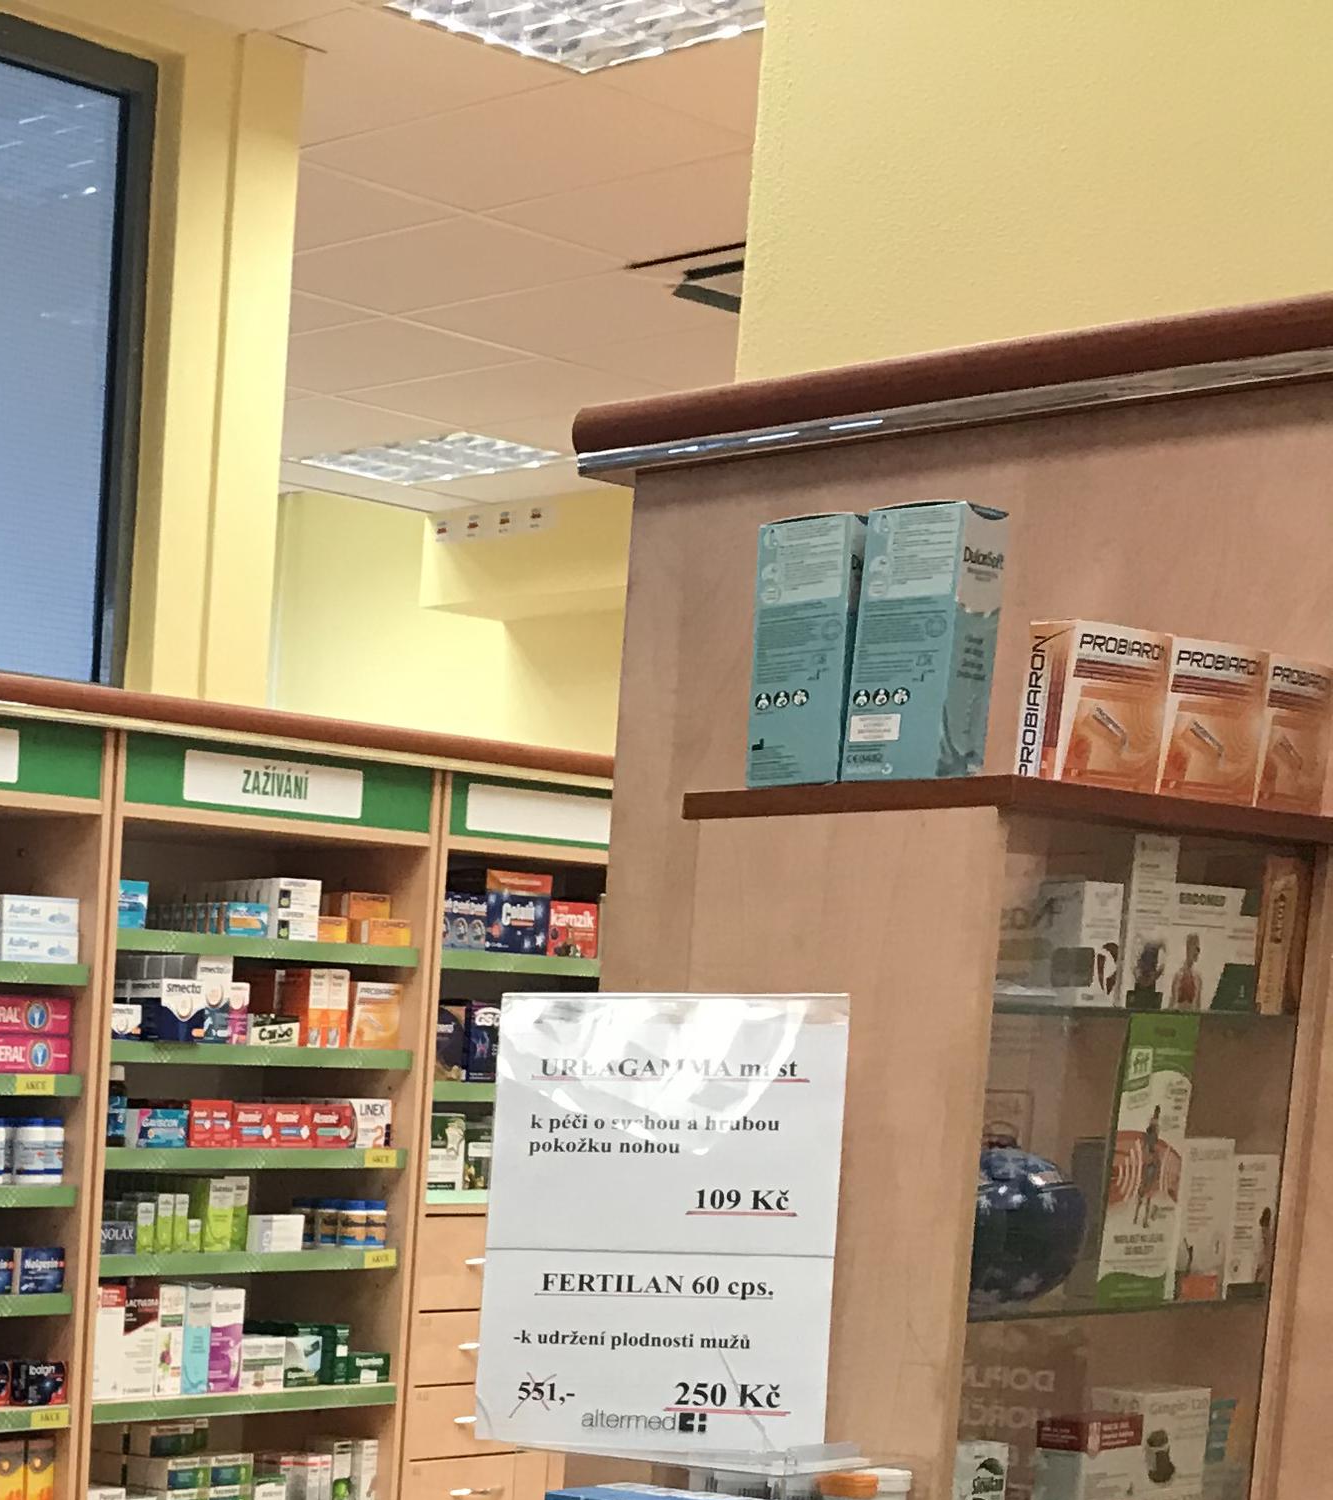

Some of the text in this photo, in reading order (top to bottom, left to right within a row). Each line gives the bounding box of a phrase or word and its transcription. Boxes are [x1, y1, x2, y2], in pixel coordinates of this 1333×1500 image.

[1018, 635, 1048, 777] PROBIARON
[241, 766, 309, 801] ZAŽÍVÁNÍ
[166, 982, 202, 995] smecta
[741, 1062, 798, 1078] mst
[531, 1114, 543, 1129] k
[549, 1113, 589, 1133] péči
[594, 1119, 605, 1130] o
[529, 1138, 680, 1156] pokožku nohou
[695, 1188, 790, 1211] 109 Kč
[542, 1272, 774, 1300] FERTILAN 60 cps.
[513, 1330, 750, 1350] -k udržení plodnosti mužů
[674, 1382, 727, 1408] 250
[738, 1383, 782, 1409] Kč
[581, 1411, 676, 1432] altermed
